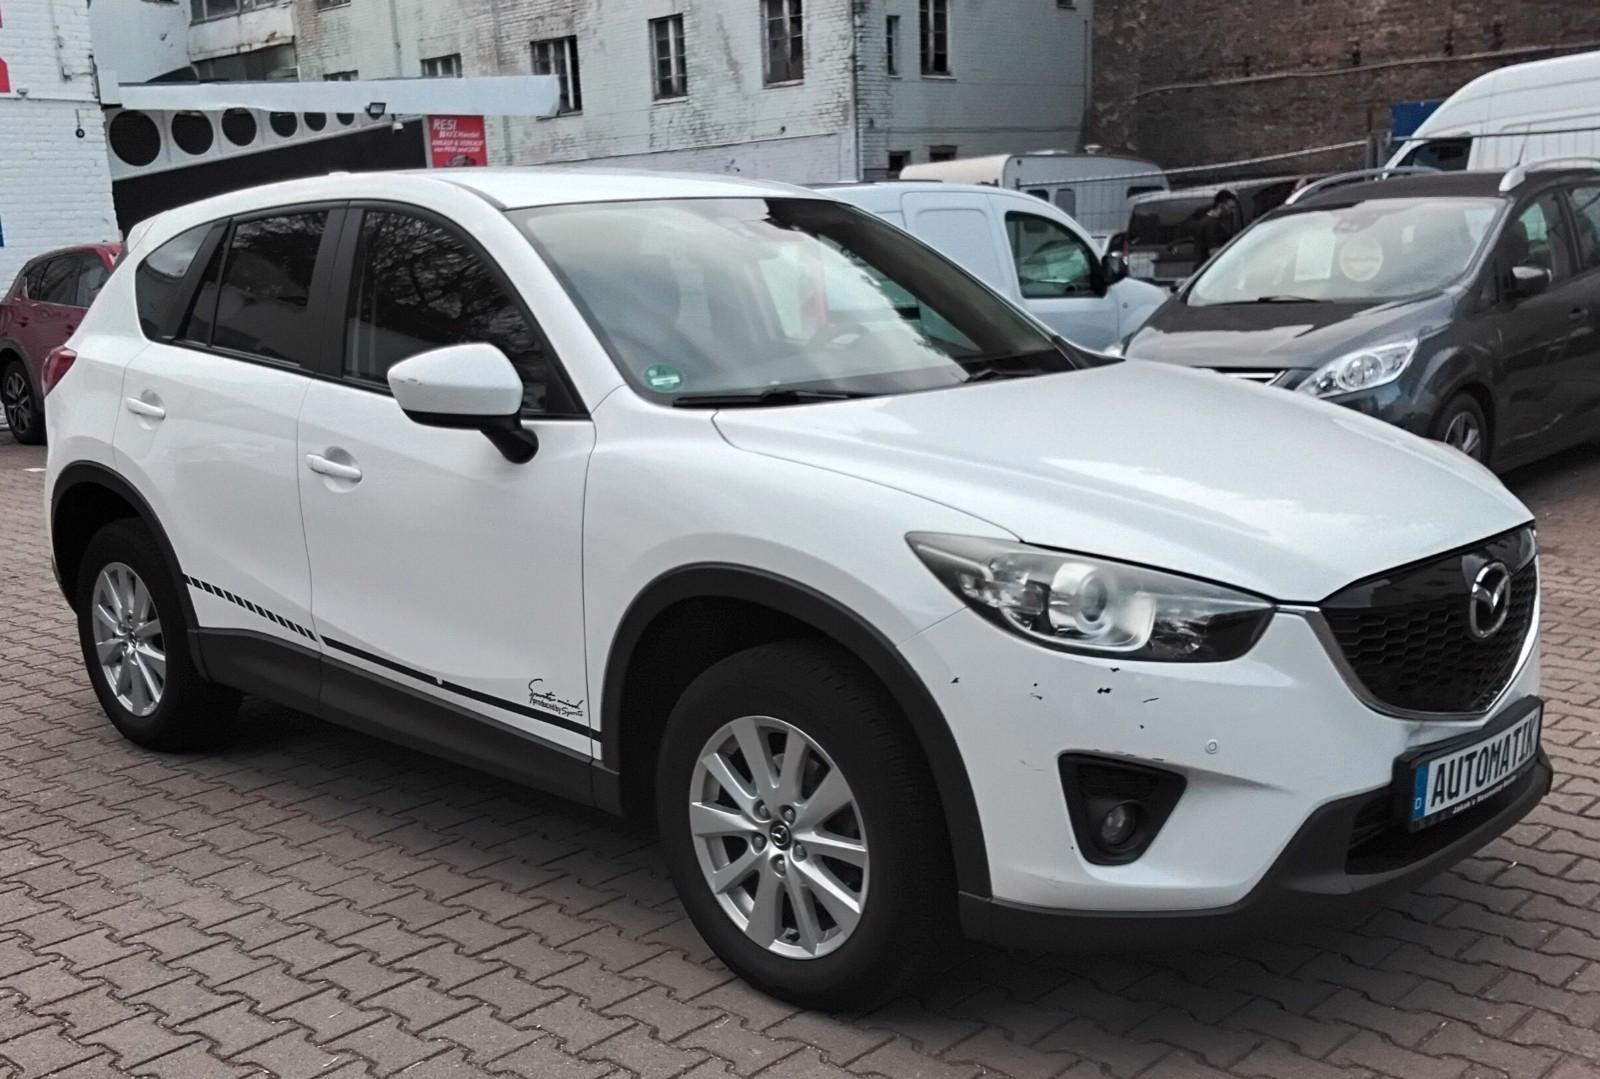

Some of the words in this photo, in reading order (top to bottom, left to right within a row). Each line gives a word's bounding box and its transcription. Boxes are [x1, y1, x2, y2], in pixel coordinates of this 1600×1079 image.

[432, 119, 457, 130] RESI
[1430, 715, 1537, 808] AUTOMATIK
[1414, 797, 1422, 810] D
